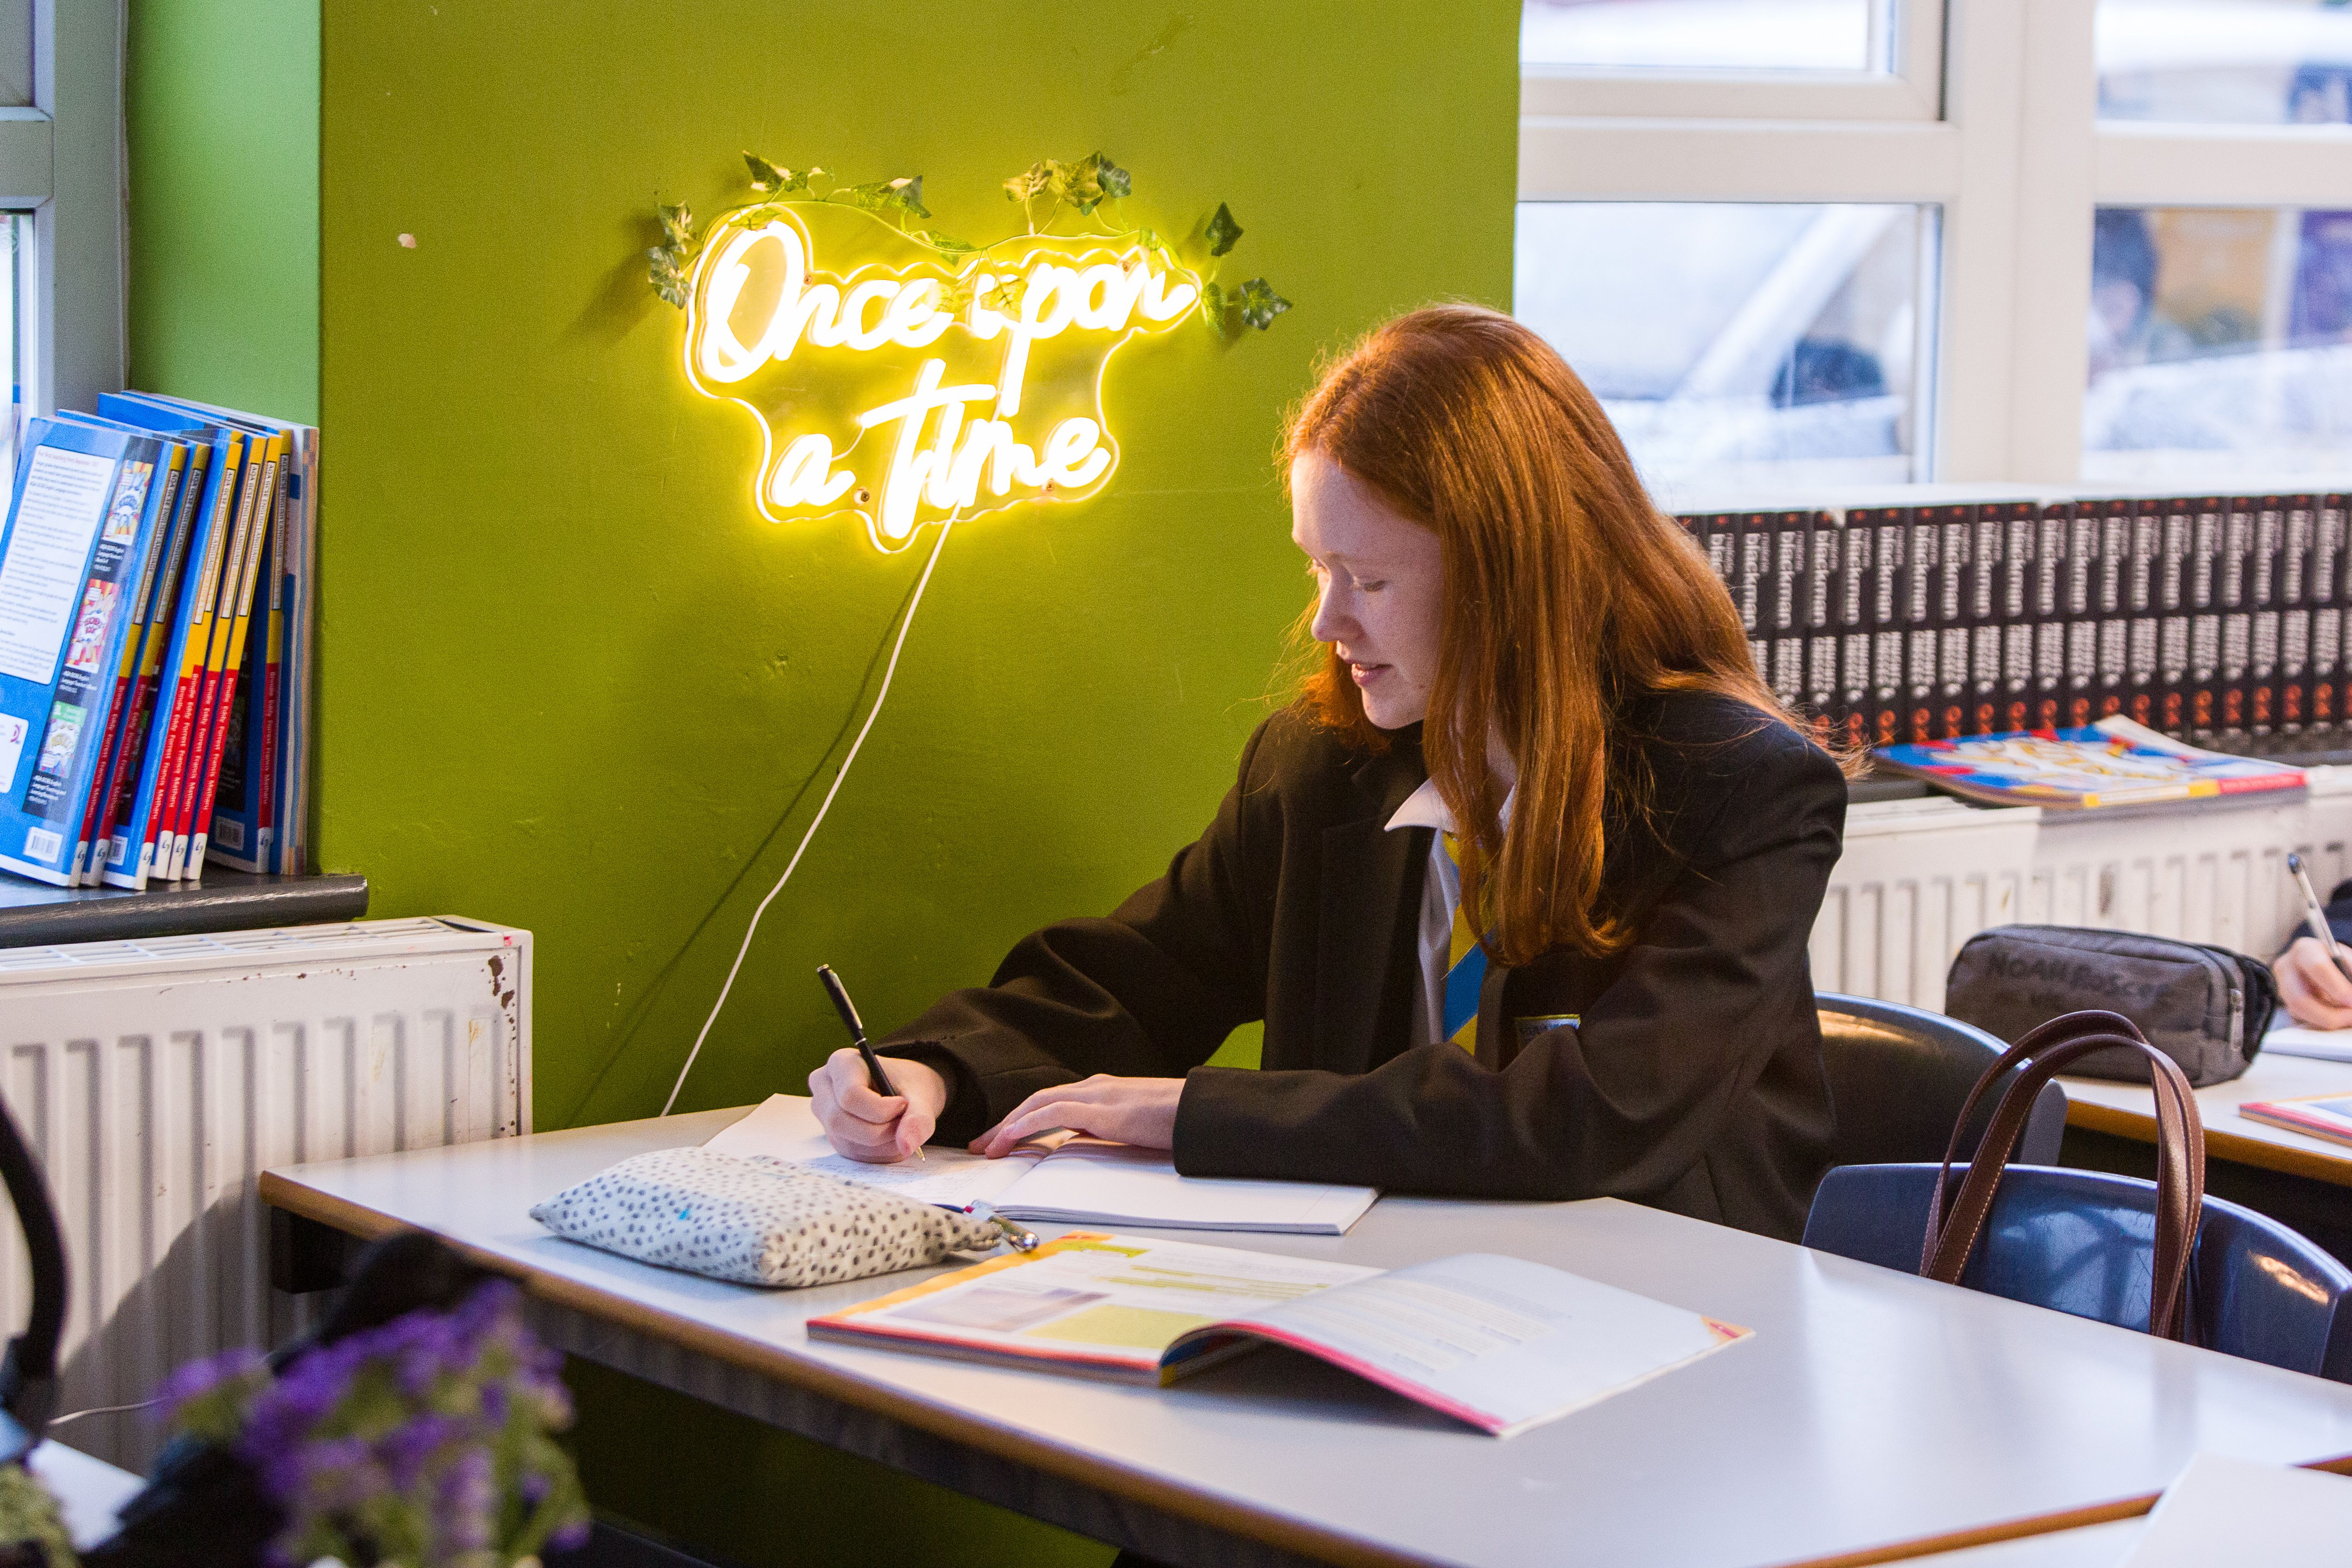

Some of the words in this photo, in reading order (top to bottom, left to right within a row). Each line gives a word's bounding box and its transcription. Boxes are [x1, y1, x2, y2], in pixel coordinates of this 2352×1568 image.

[702, 218, 957, 383] Once
[969, 259, 1198, 418] upon
[770, 433, 857, 507] a
[175, 685, 186, 711] Brindle
[188, 673, 198, 699] Brindle
[205, 679, 216, 705] Brindle
[223, 677, 233, 702] Brindle
[164, 734, 175, 759] Forrest
[180, 722, 190, 747] Forrest
[196, 727, 205, 753] Forrest
[214, 725, 224, 750] Forrest
[158, 761, 170, 786] Francis
[175, 749, 185, 774] Francis
[191, 755, 201, 779] Francis
[209, 752, 219, 777] Francis
